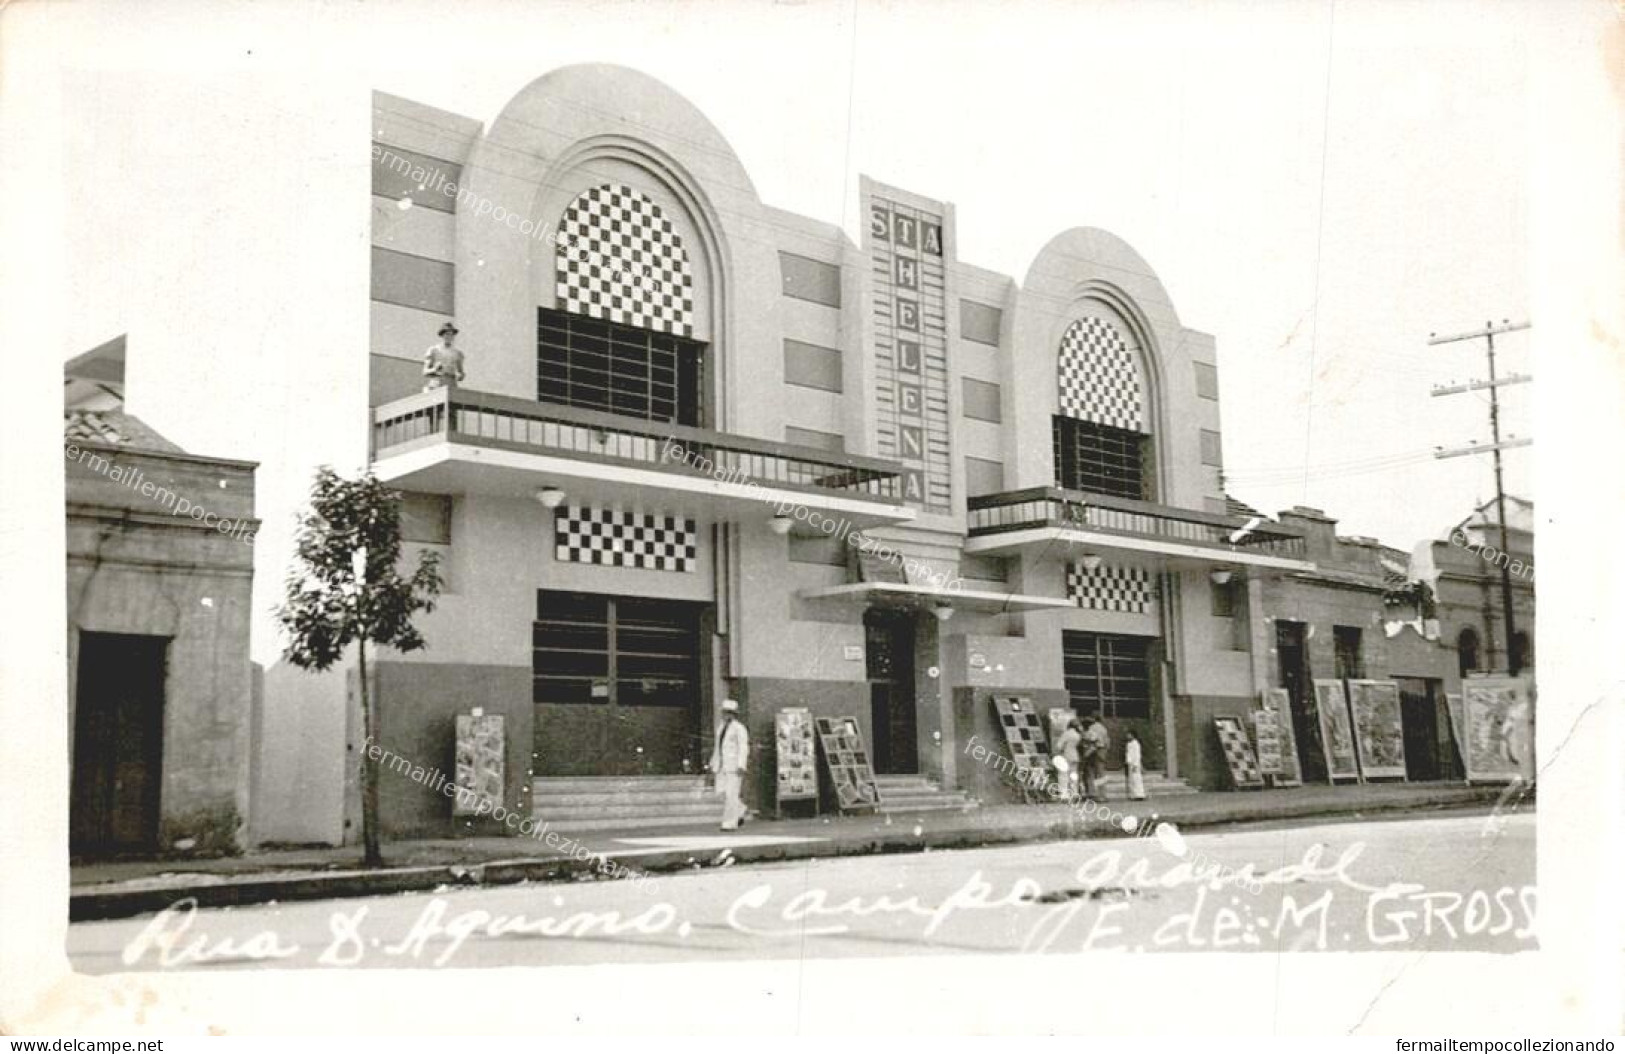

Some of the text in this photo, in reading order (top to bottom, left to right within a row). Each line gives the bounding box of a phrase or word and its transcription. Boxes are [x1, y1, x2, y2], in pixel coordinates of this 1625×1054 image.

[872, 208, 940, 254] STA
[899, 257, 923, 500] HELENA
[122, 897, 298, 967] Rua
[727, 871, 1041, 938] Campo
